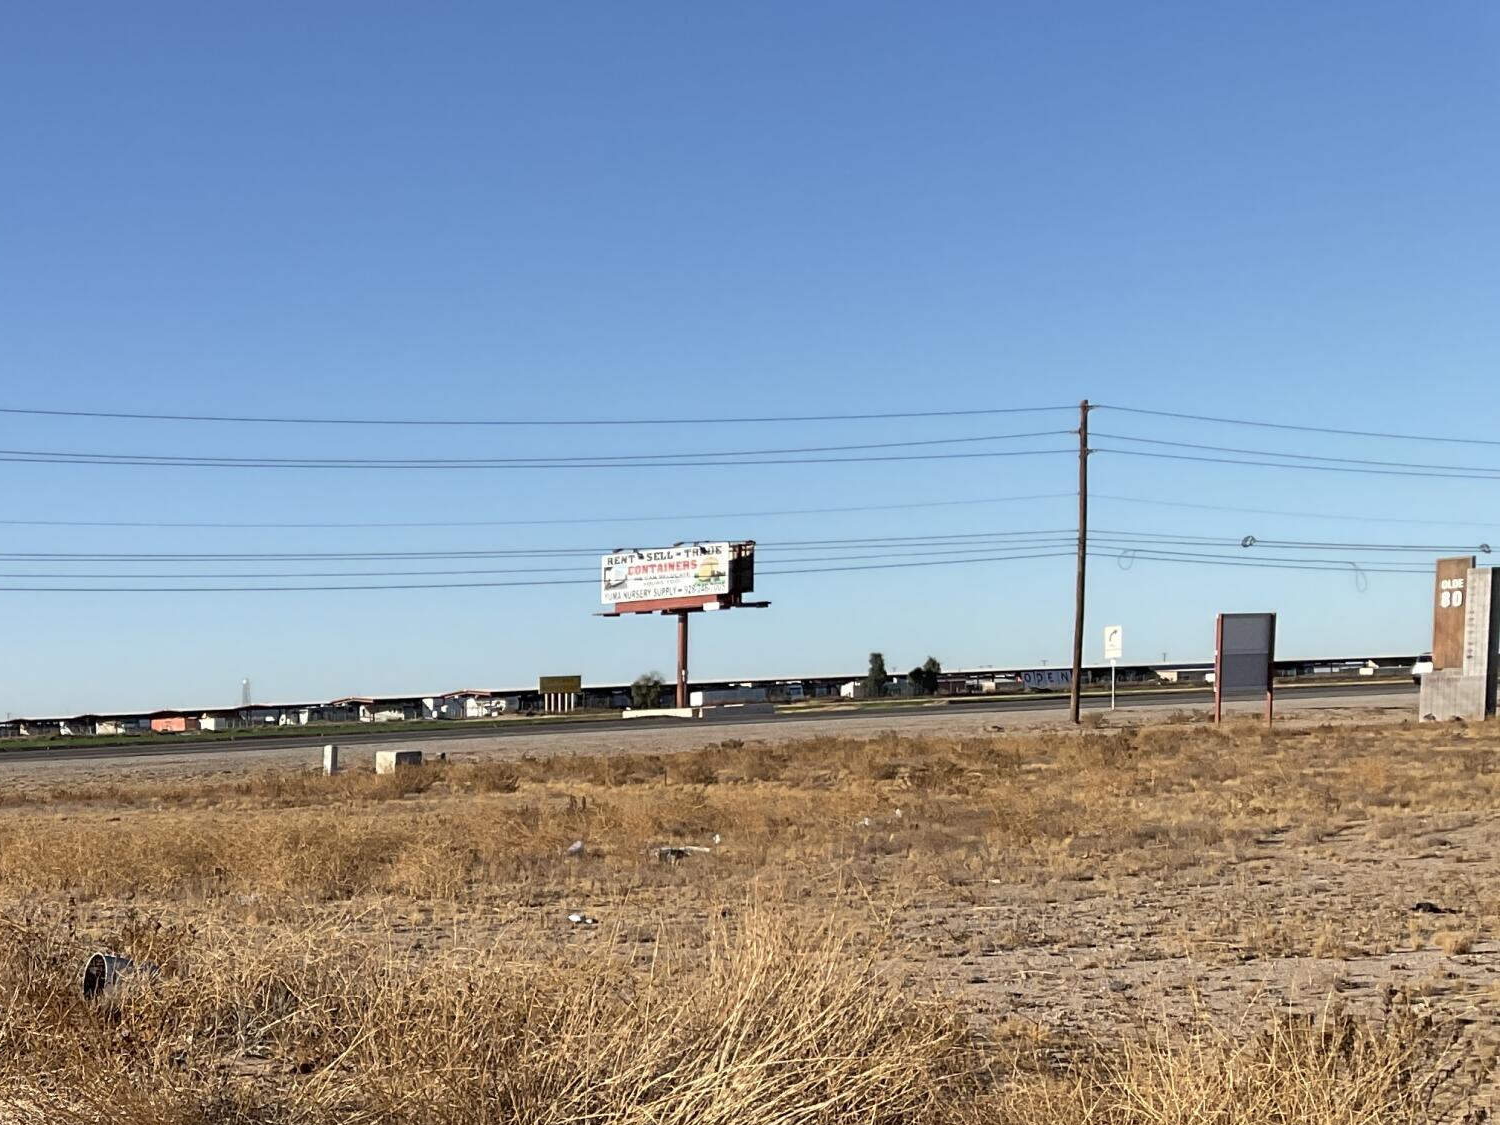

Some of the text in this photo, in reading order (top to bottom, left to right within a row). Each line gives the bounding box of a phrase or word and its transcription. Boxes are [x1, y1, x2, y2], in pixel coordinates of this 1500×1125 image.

[607, 555, 635, 565] RENT
[646, 551, 673, 561] SELL
[628, 559, 698, 575] CONTAINERS
[1441, 579, 1464, 589] OLDE
[623, 588, 651, 599] NURSERY
[653, 585, 677, 597] SUPPLY
[1441, 590, 1463, 608] 80
[1024, 672, 1069, 684] OPEN
